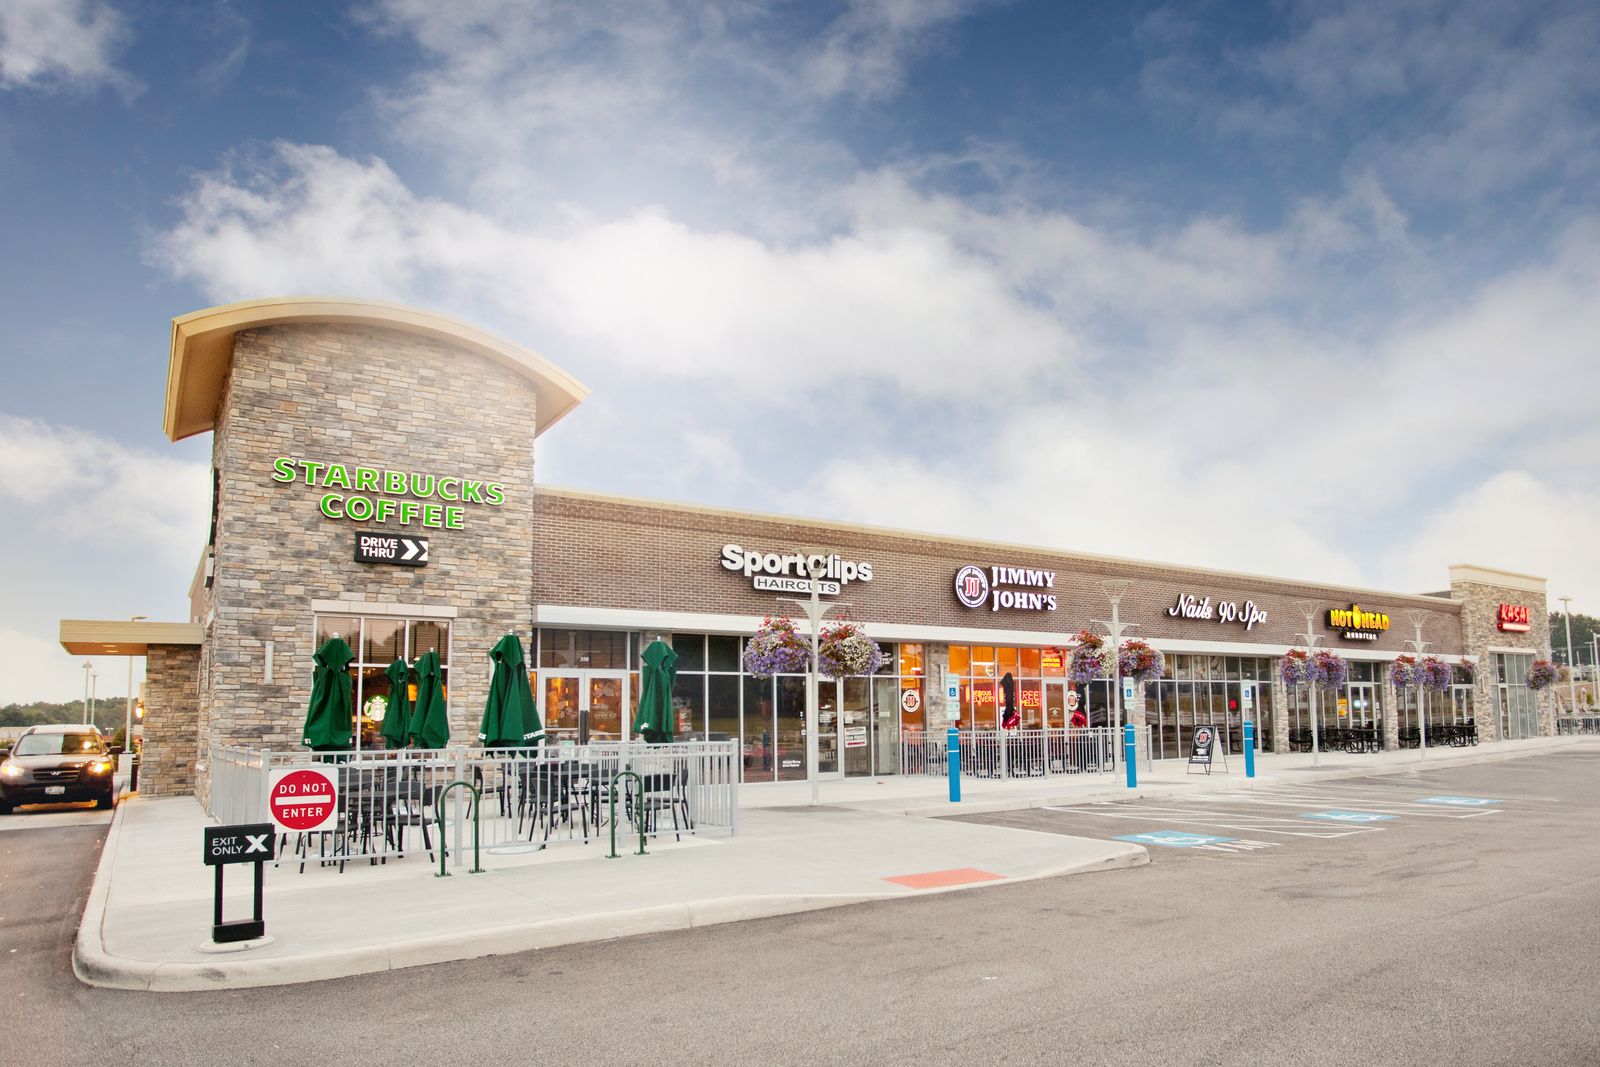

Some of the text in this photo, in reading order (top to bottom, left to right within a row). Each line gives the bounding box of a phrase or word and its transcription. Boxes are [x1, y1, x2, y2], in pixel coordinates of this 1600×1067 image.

[272, 457, 505, 506] STARBUCKS
[320, 493, 465, 530] COFFEE
[360, 536, 398, 550] DRIVE
[361, 547, 396, 559] THRU
[991, 566, 1056, 587] JIMMY
[965, 577, 979, 597] JJ
[992, 590, 1057, 612] JOHN'S
[1168, 593, 1212, 619] Nails
[1238, 600, 1267, 631] Spa
[1330, 609, 1390, 630] HOT HEAD
[280, 783, 327, 794] DO NOT
[282, 807, 323, 818] ENTER
[212, 836, 238, 846] EXIT
[212, 846, 243, 856] ONLY
